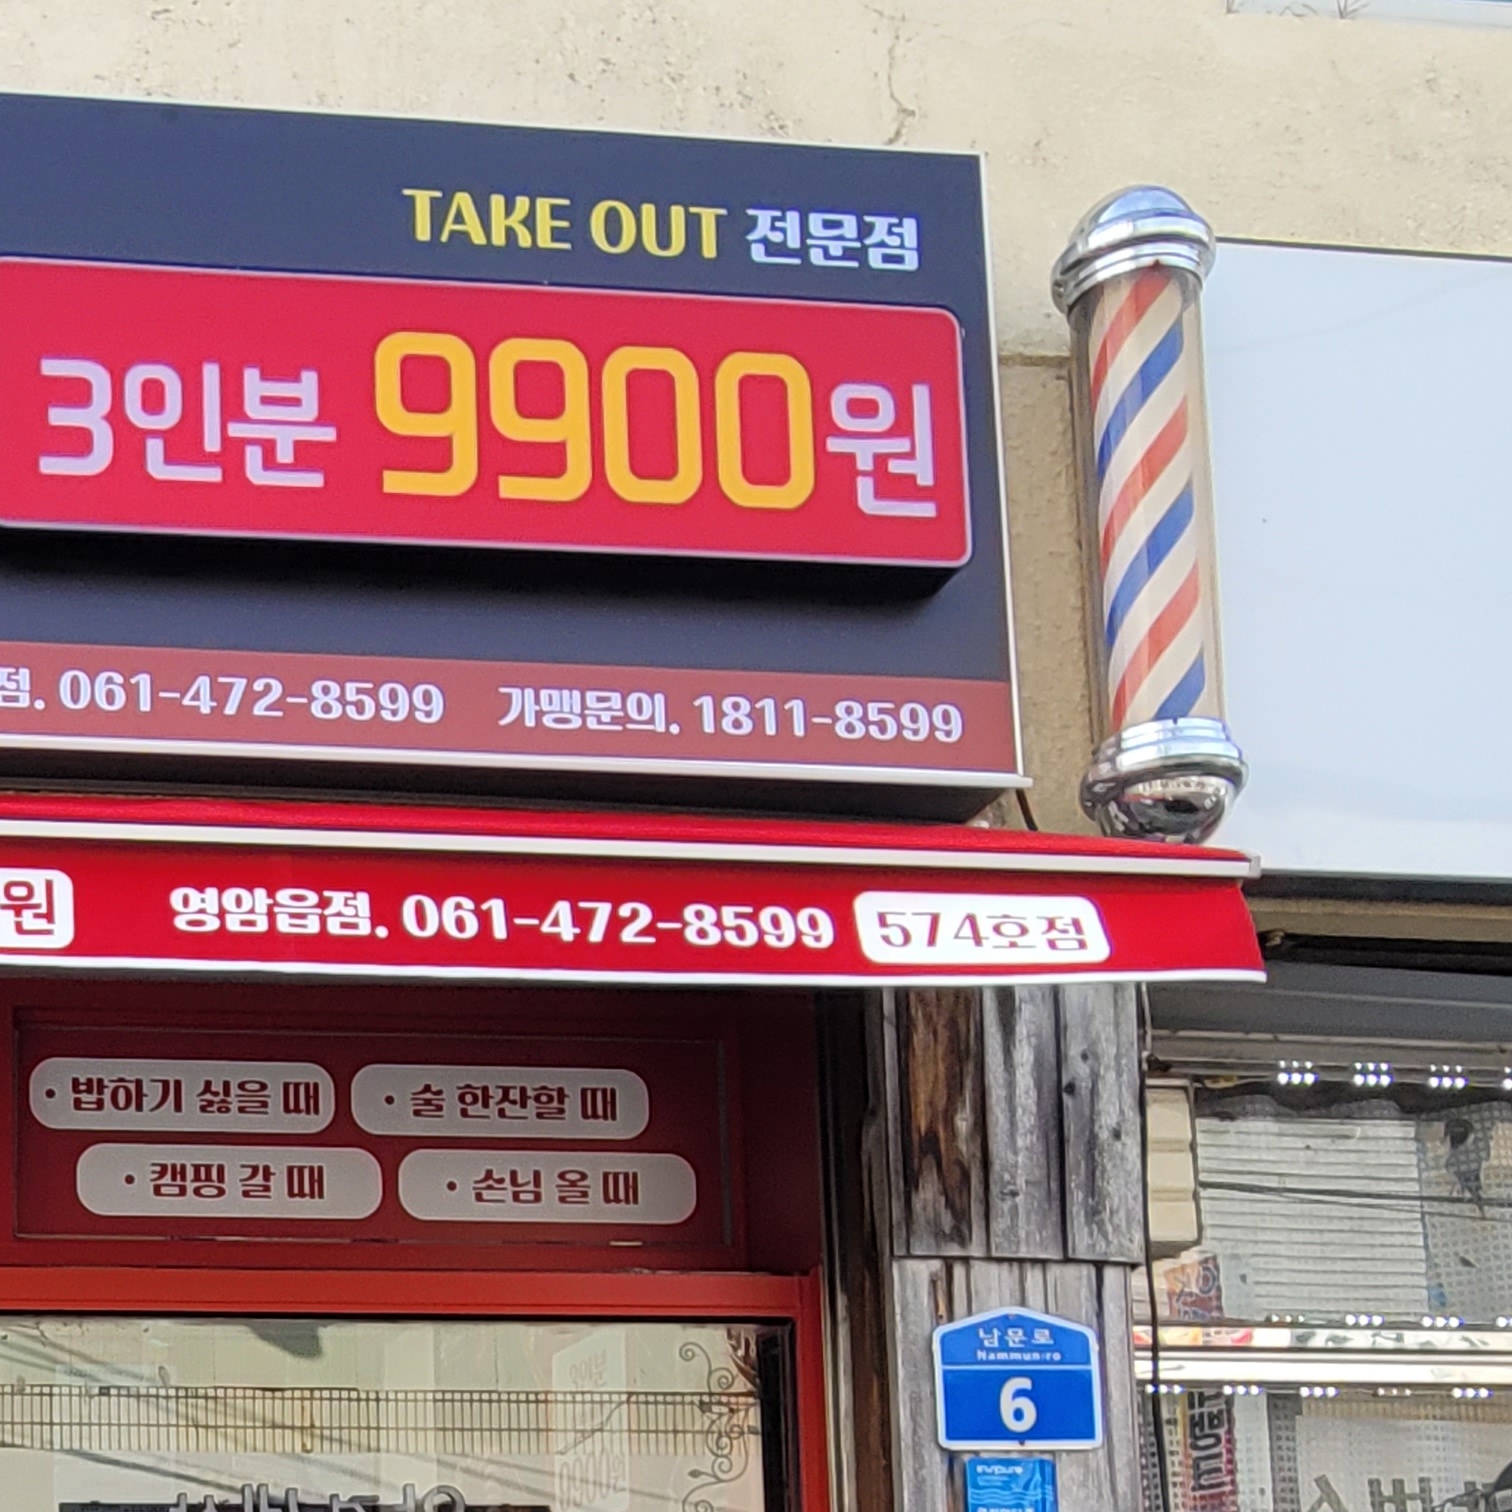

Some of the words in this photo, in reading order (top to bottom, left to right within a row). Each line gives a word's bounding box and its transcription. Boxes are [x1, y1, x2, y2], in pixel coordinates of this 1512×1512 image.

[402, 188, 572, 251] TAKE
[590, 200, 727, 259] OUT
[744, 207, 920, 271] 전문점
[37, 356, 338, 488] 3인분
[374, 330, 937, 517] 9900원
[58, 669, 444, 725] 061-472-8599
[498, 683, 681, 737] 가맹문의.
[692, 694, 962, 743] 1811-8599
[169, 885, 391, 941] 영암읍점.
[401, 893, 834, 949] 061-472-8599
[876, 907, 1090, 954] 574호점
[70, 1075, 184, 1116] 밥하기
[195, 1078, 271, 1116] 싫을
[281, 1079, 320, 1117] 때
[409, 1082, 447, 1121] 술
[456, 1082, 570, 1122] 한잔할
[579, 1085, 618, 1124] 때
[148, 1161, 228, 1200] 캠핑
[238, 1163, 276, 1200] 갈
[285, 1163, 326, 1201] 때
[471, 1167, 542, 1206] 손님
[554, 1168, 592, 1206] 올
[602, 1169, 641, 1207] 때
[978, 1326, 1055, 1348] 남문로
[999, 1375, 1038, 1434] 6
